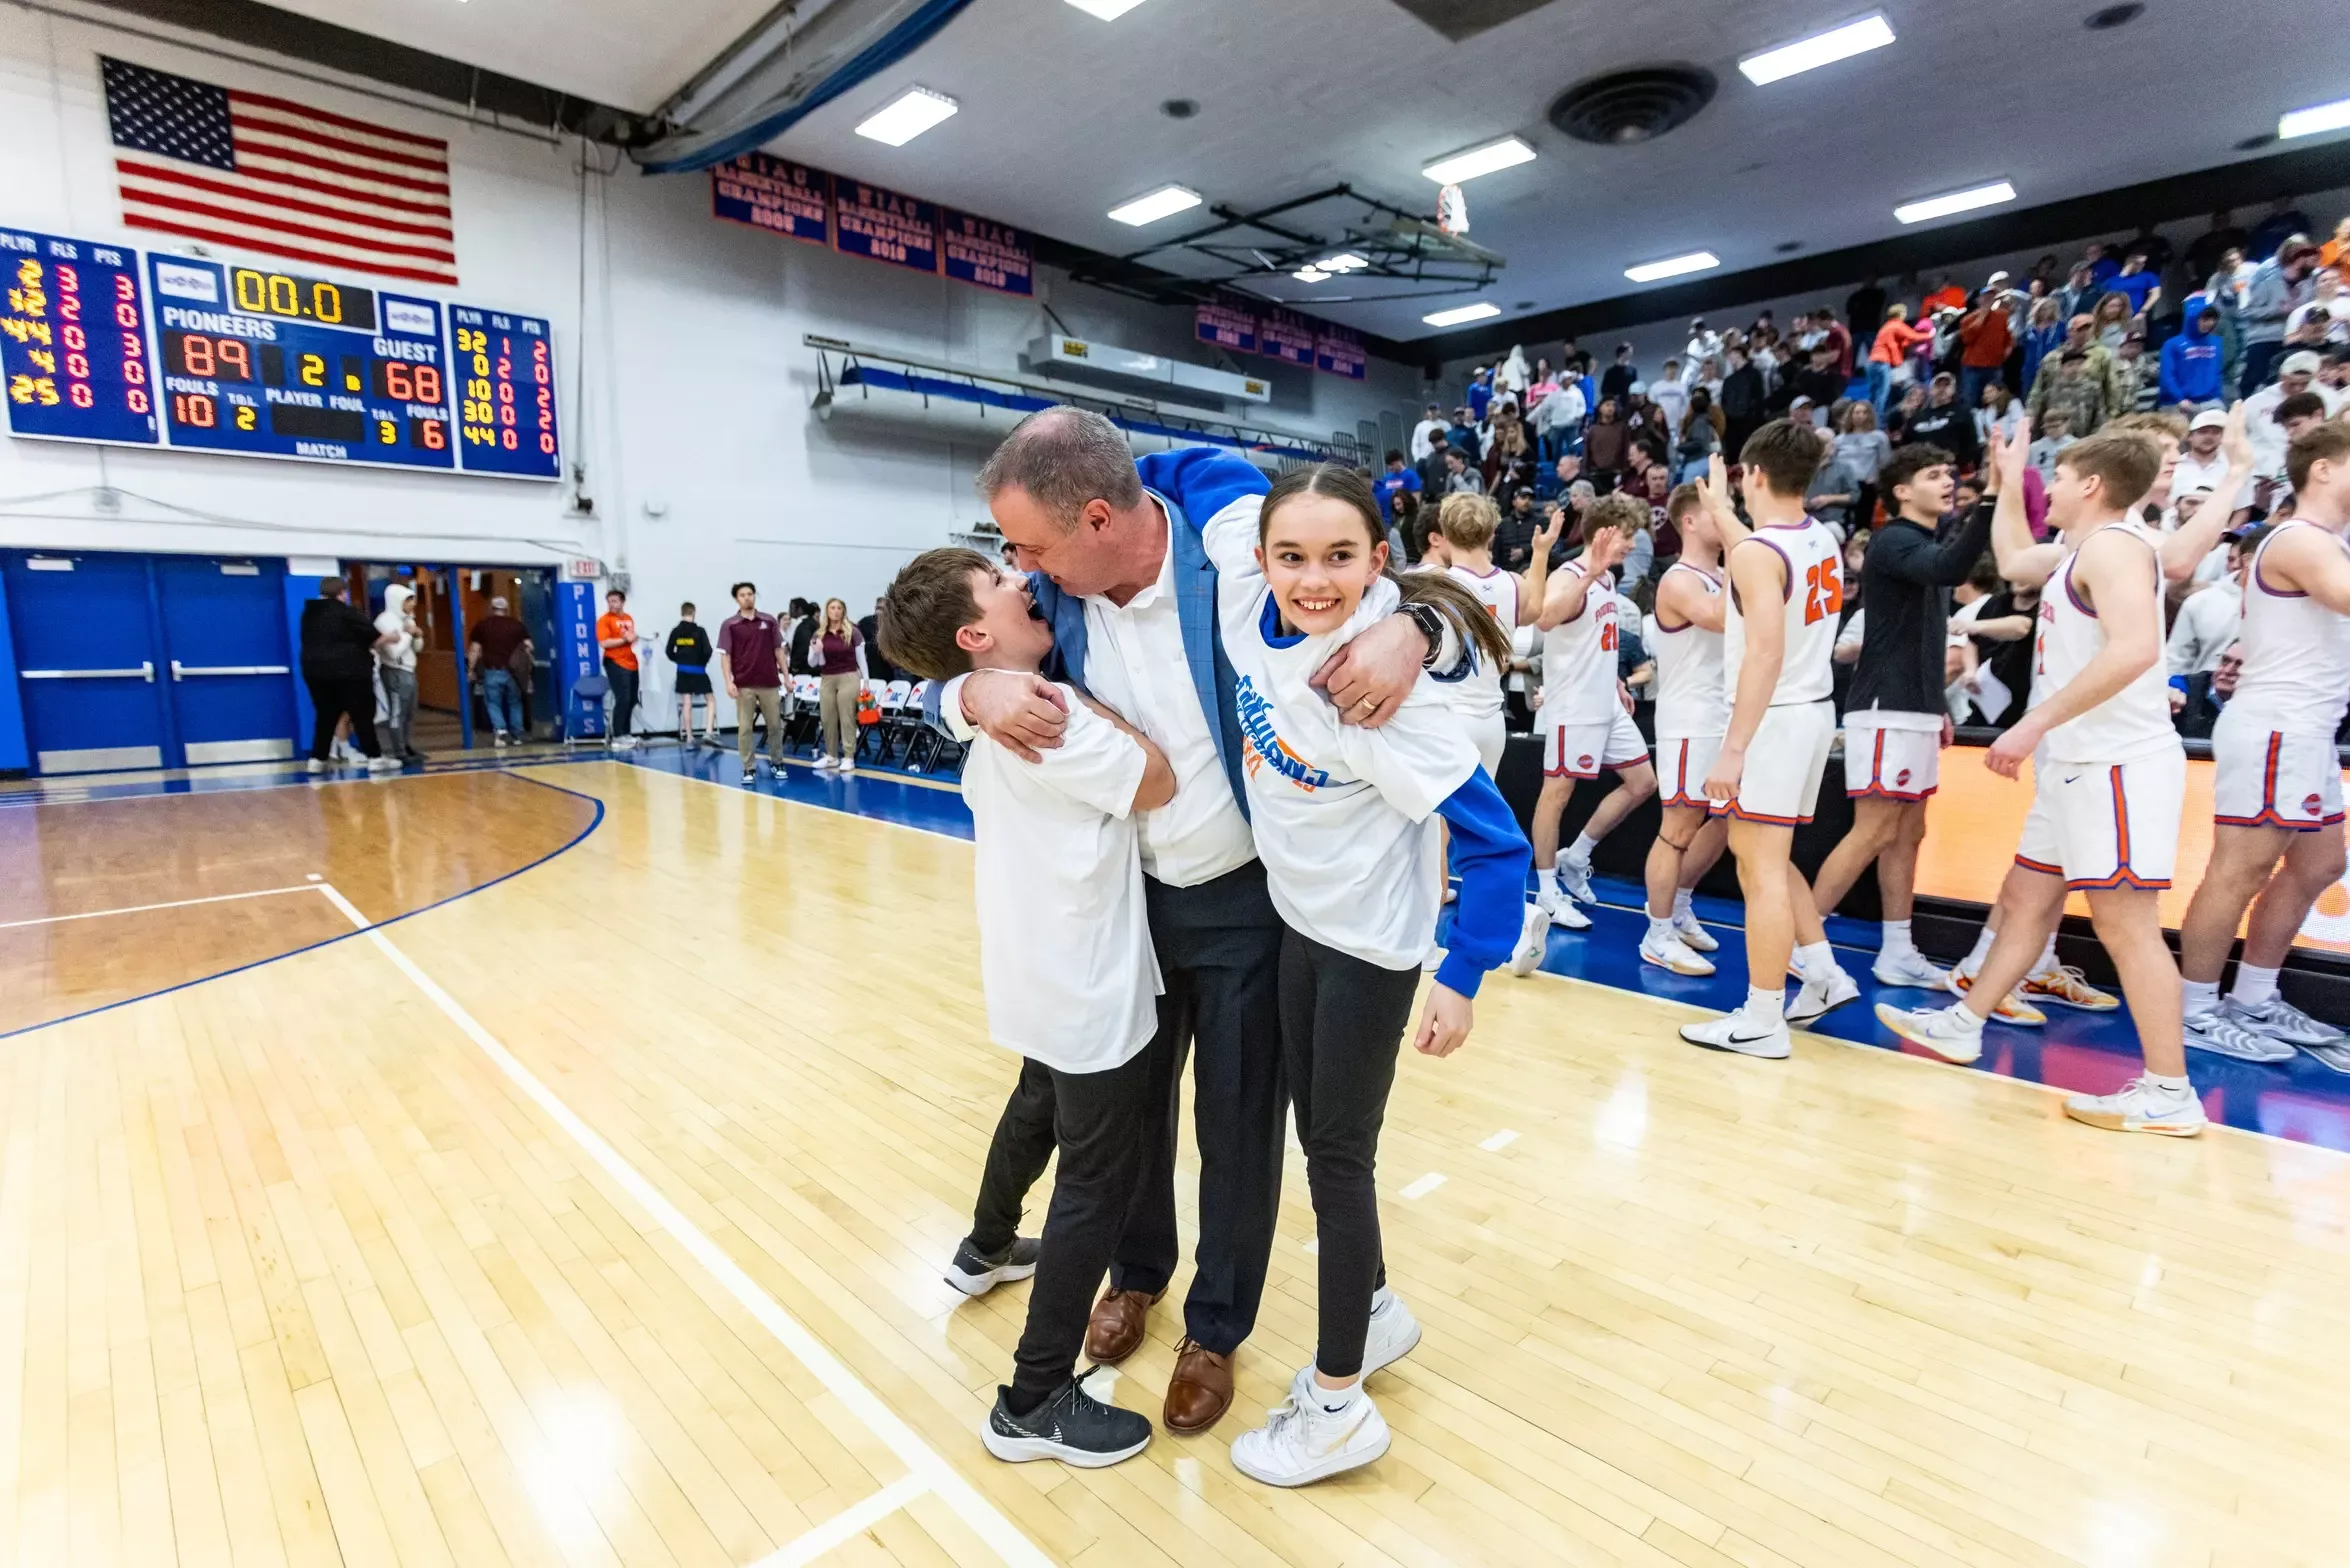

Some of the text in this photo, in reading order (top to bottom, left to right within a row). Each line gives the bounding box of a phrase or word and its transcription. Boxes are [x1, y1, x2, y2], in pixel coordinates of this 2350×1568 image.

[718, 180, 824, 222] CHAMPIONS
[837, 197, 933, 236] BASKETBALL
[839, 214, 933, 251] CHAMPIONS
[49, 241, 78, 260] FLS
[947, 244, 1029, 277] CHAMPIONS
[18, 258, 43, 288] 2
[56, 265, 79, 292] 3
[114, 274, 136, 301] 3
[59, 293, 81, 320] 2
[117, 303, 139, 328] 0
[236, 269, 342, 324] 00.0
[163, 306, 277, 341] PIONEERS
[62, 324, 87, 351] 0
[121, 332, 142, 358] 3
[183, 334, 251, 379] 89
[373, 337, 437, 363] GUEST
[457, 328, 547, 362] 32 1 2
[66, 353, 90, 379] 0
[123, 360, 145, 385] 0
[302, 354, 325, 387] 2
[385, 361, 441, 404] 68
[473, 354, 549, 384] 0 2 0
[10, 374, 149, 414] 25 0 0
[165, 376, 219, 397] FOULS
[265, 388, 367, 412] PLAYER FOUL
[468, 379, 551, 408] 10 0 2
[176, 394, 215, 428] 10
[236, 406, 256, 431] 2
[406, 404, 449, 422] FOULS
[464, 399, 552, 430] 30 0 2
[380, 420, 397, 444] 3
[422, 420, 445, 450] 6
[464, 425, 555, 454] 44 0 0
[296, 442, 347, 459] MATCH
[1805, 555, 1843, 627] 25
[573, 584, 596, 735] PIONES
